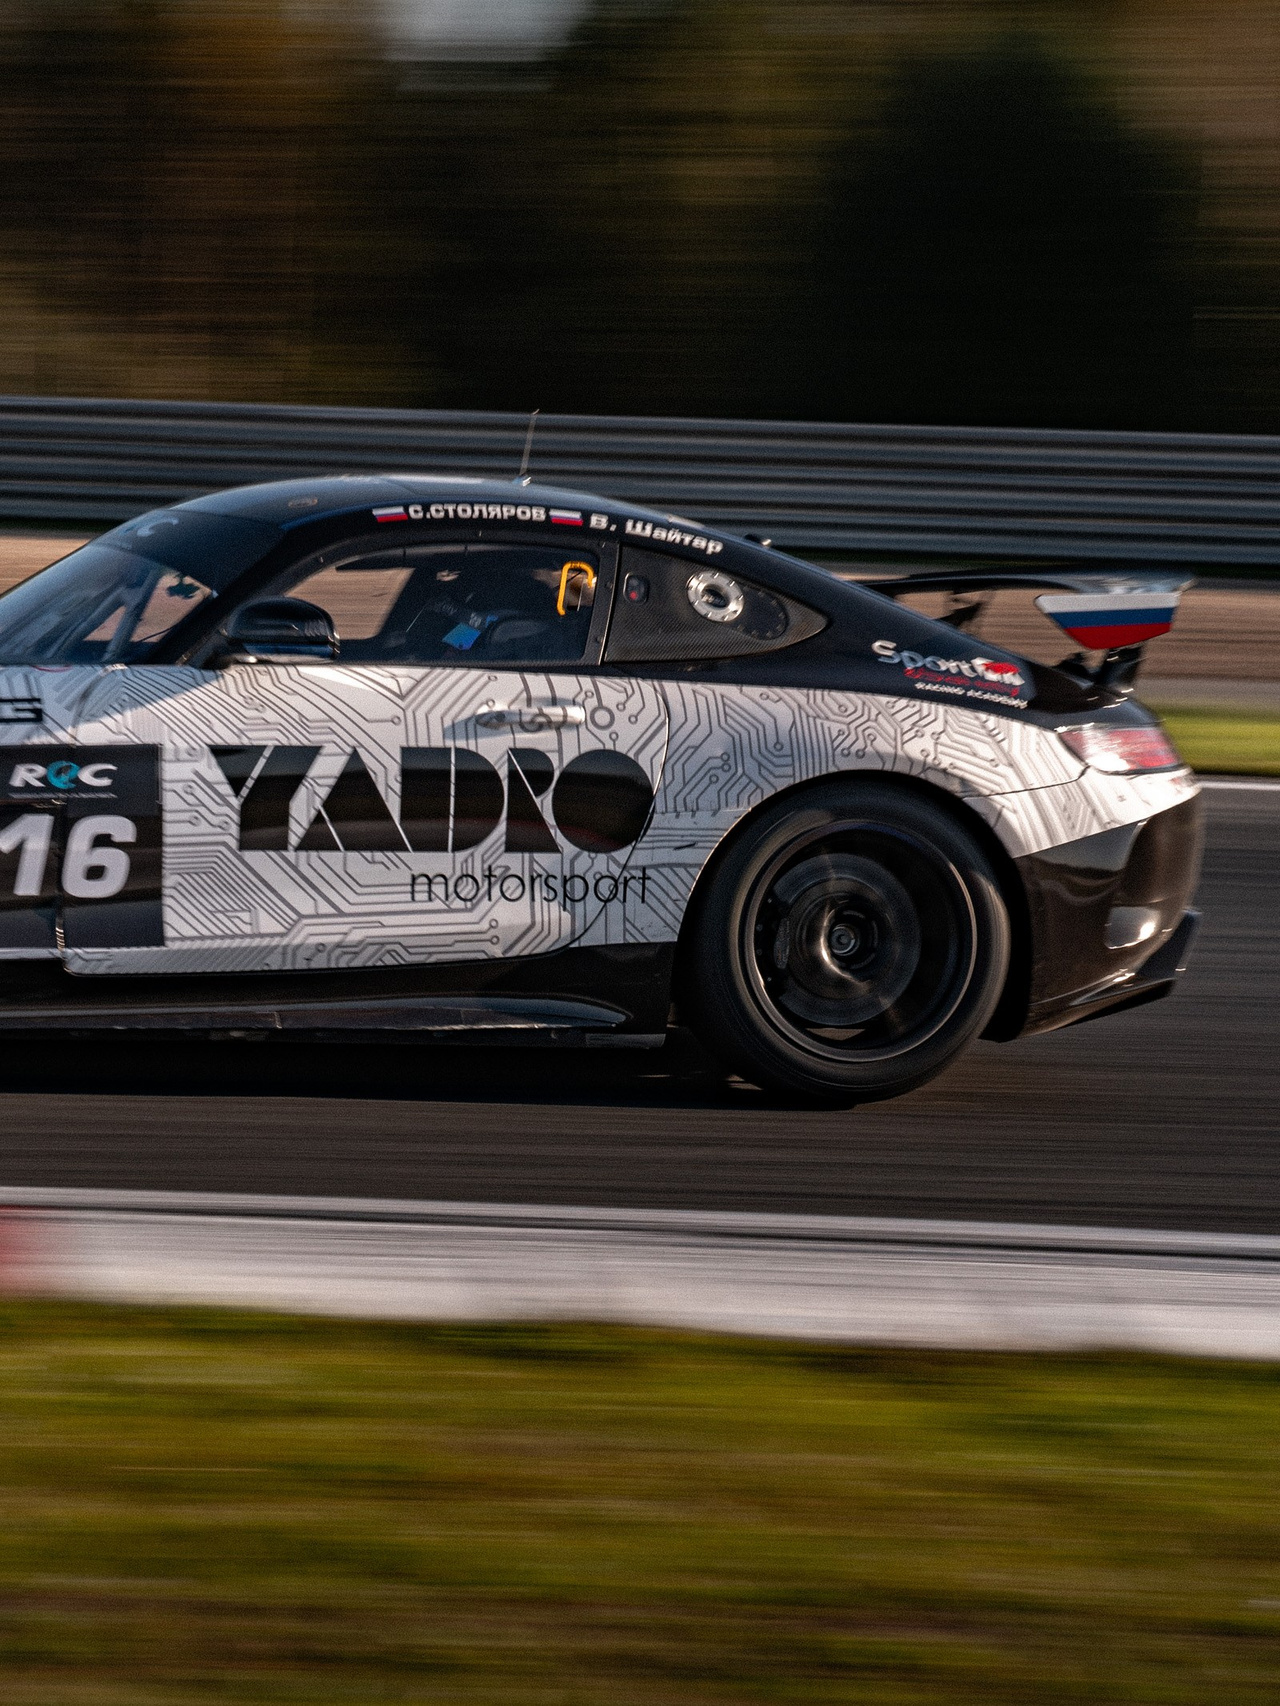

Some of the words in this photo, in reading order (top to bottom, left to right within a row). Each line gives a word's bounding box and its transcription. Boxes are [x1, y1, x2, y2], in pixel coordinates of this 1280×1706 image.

[624, 518, 723, 556] Шайтар
[871, 640, 978, 677] Sport
[206, 744, 658, 854] YADRO
[409, 864, 652, 906] motorsport
